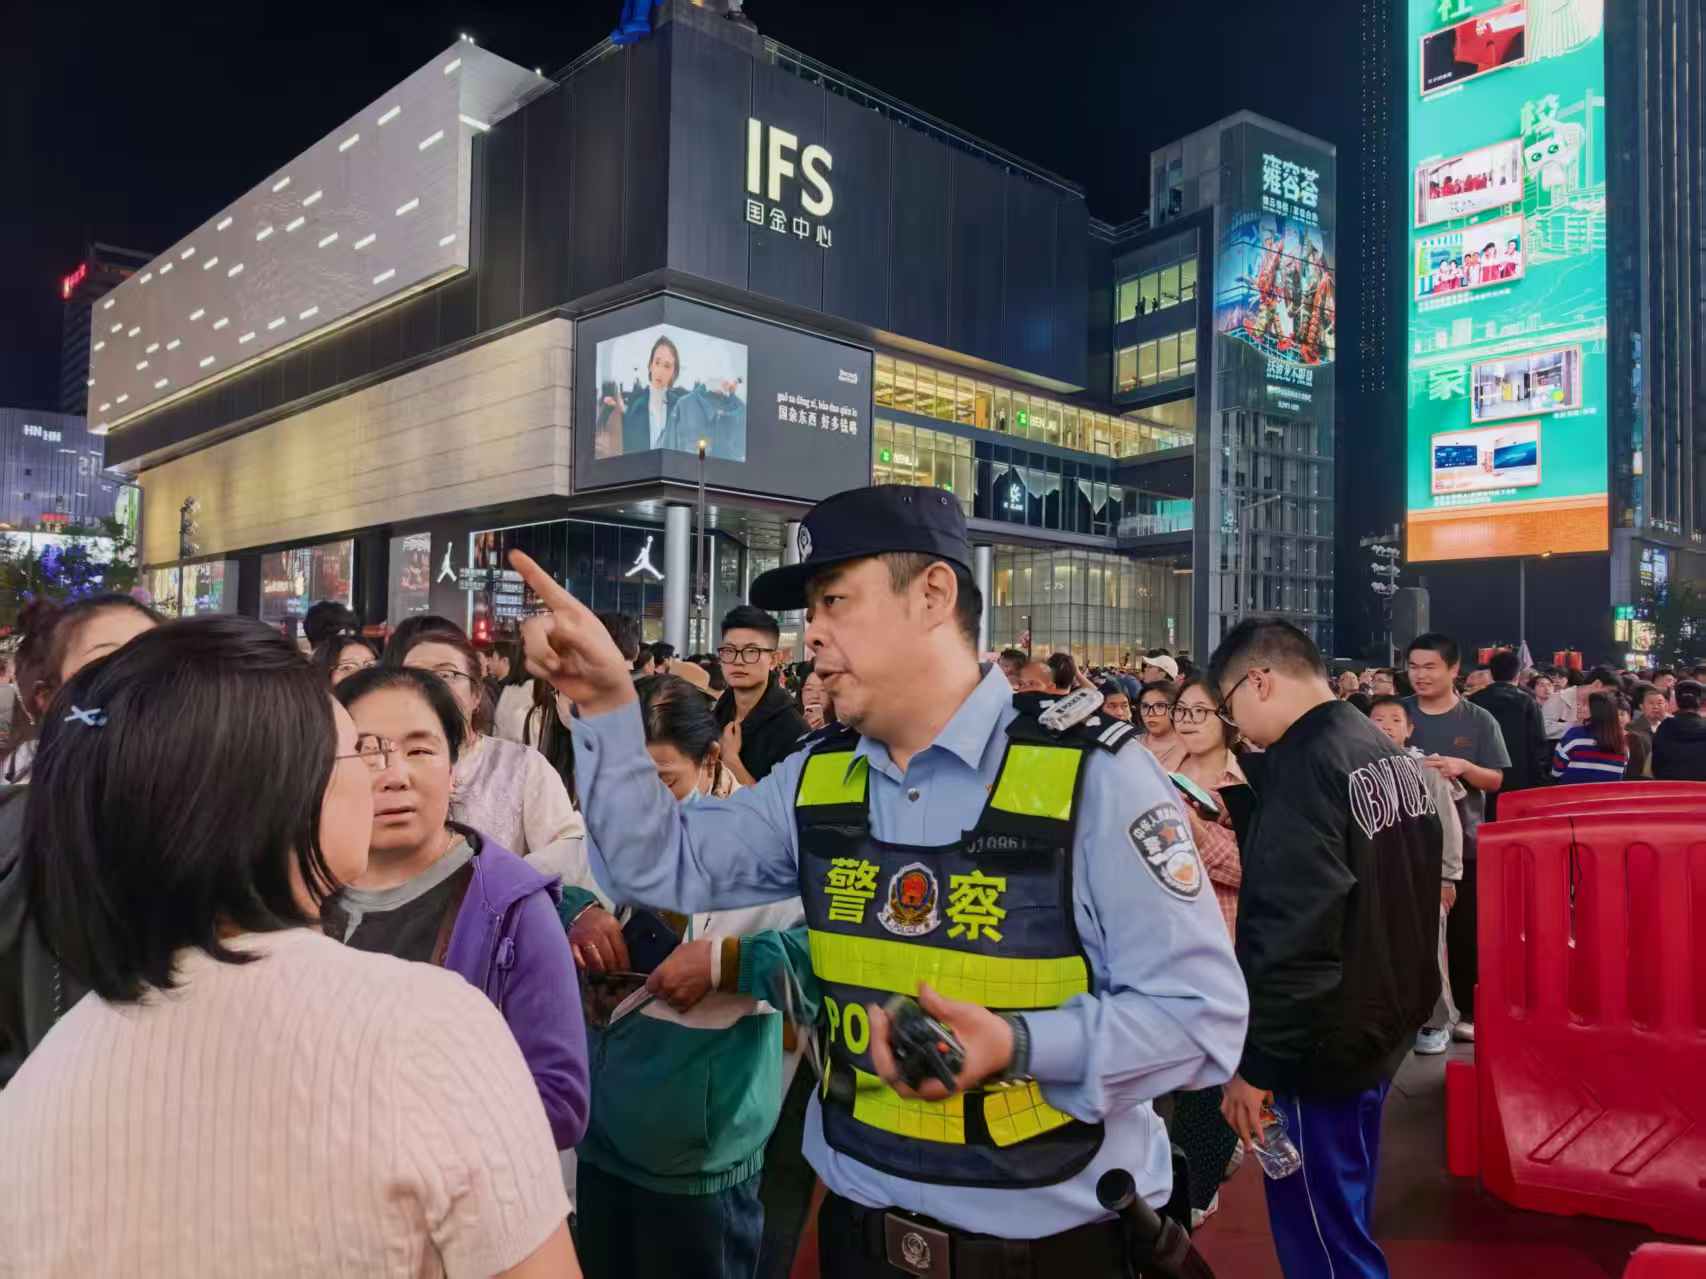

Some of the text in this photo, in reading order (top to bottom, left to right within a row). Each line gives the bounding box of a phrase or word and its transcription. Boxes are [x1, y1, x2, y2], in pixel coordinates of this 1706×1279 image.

[747, 117, 834, 217] IFS
[746, 199, 833, 249] 国金中心
[824, 858, 1008, 943] 警 察
